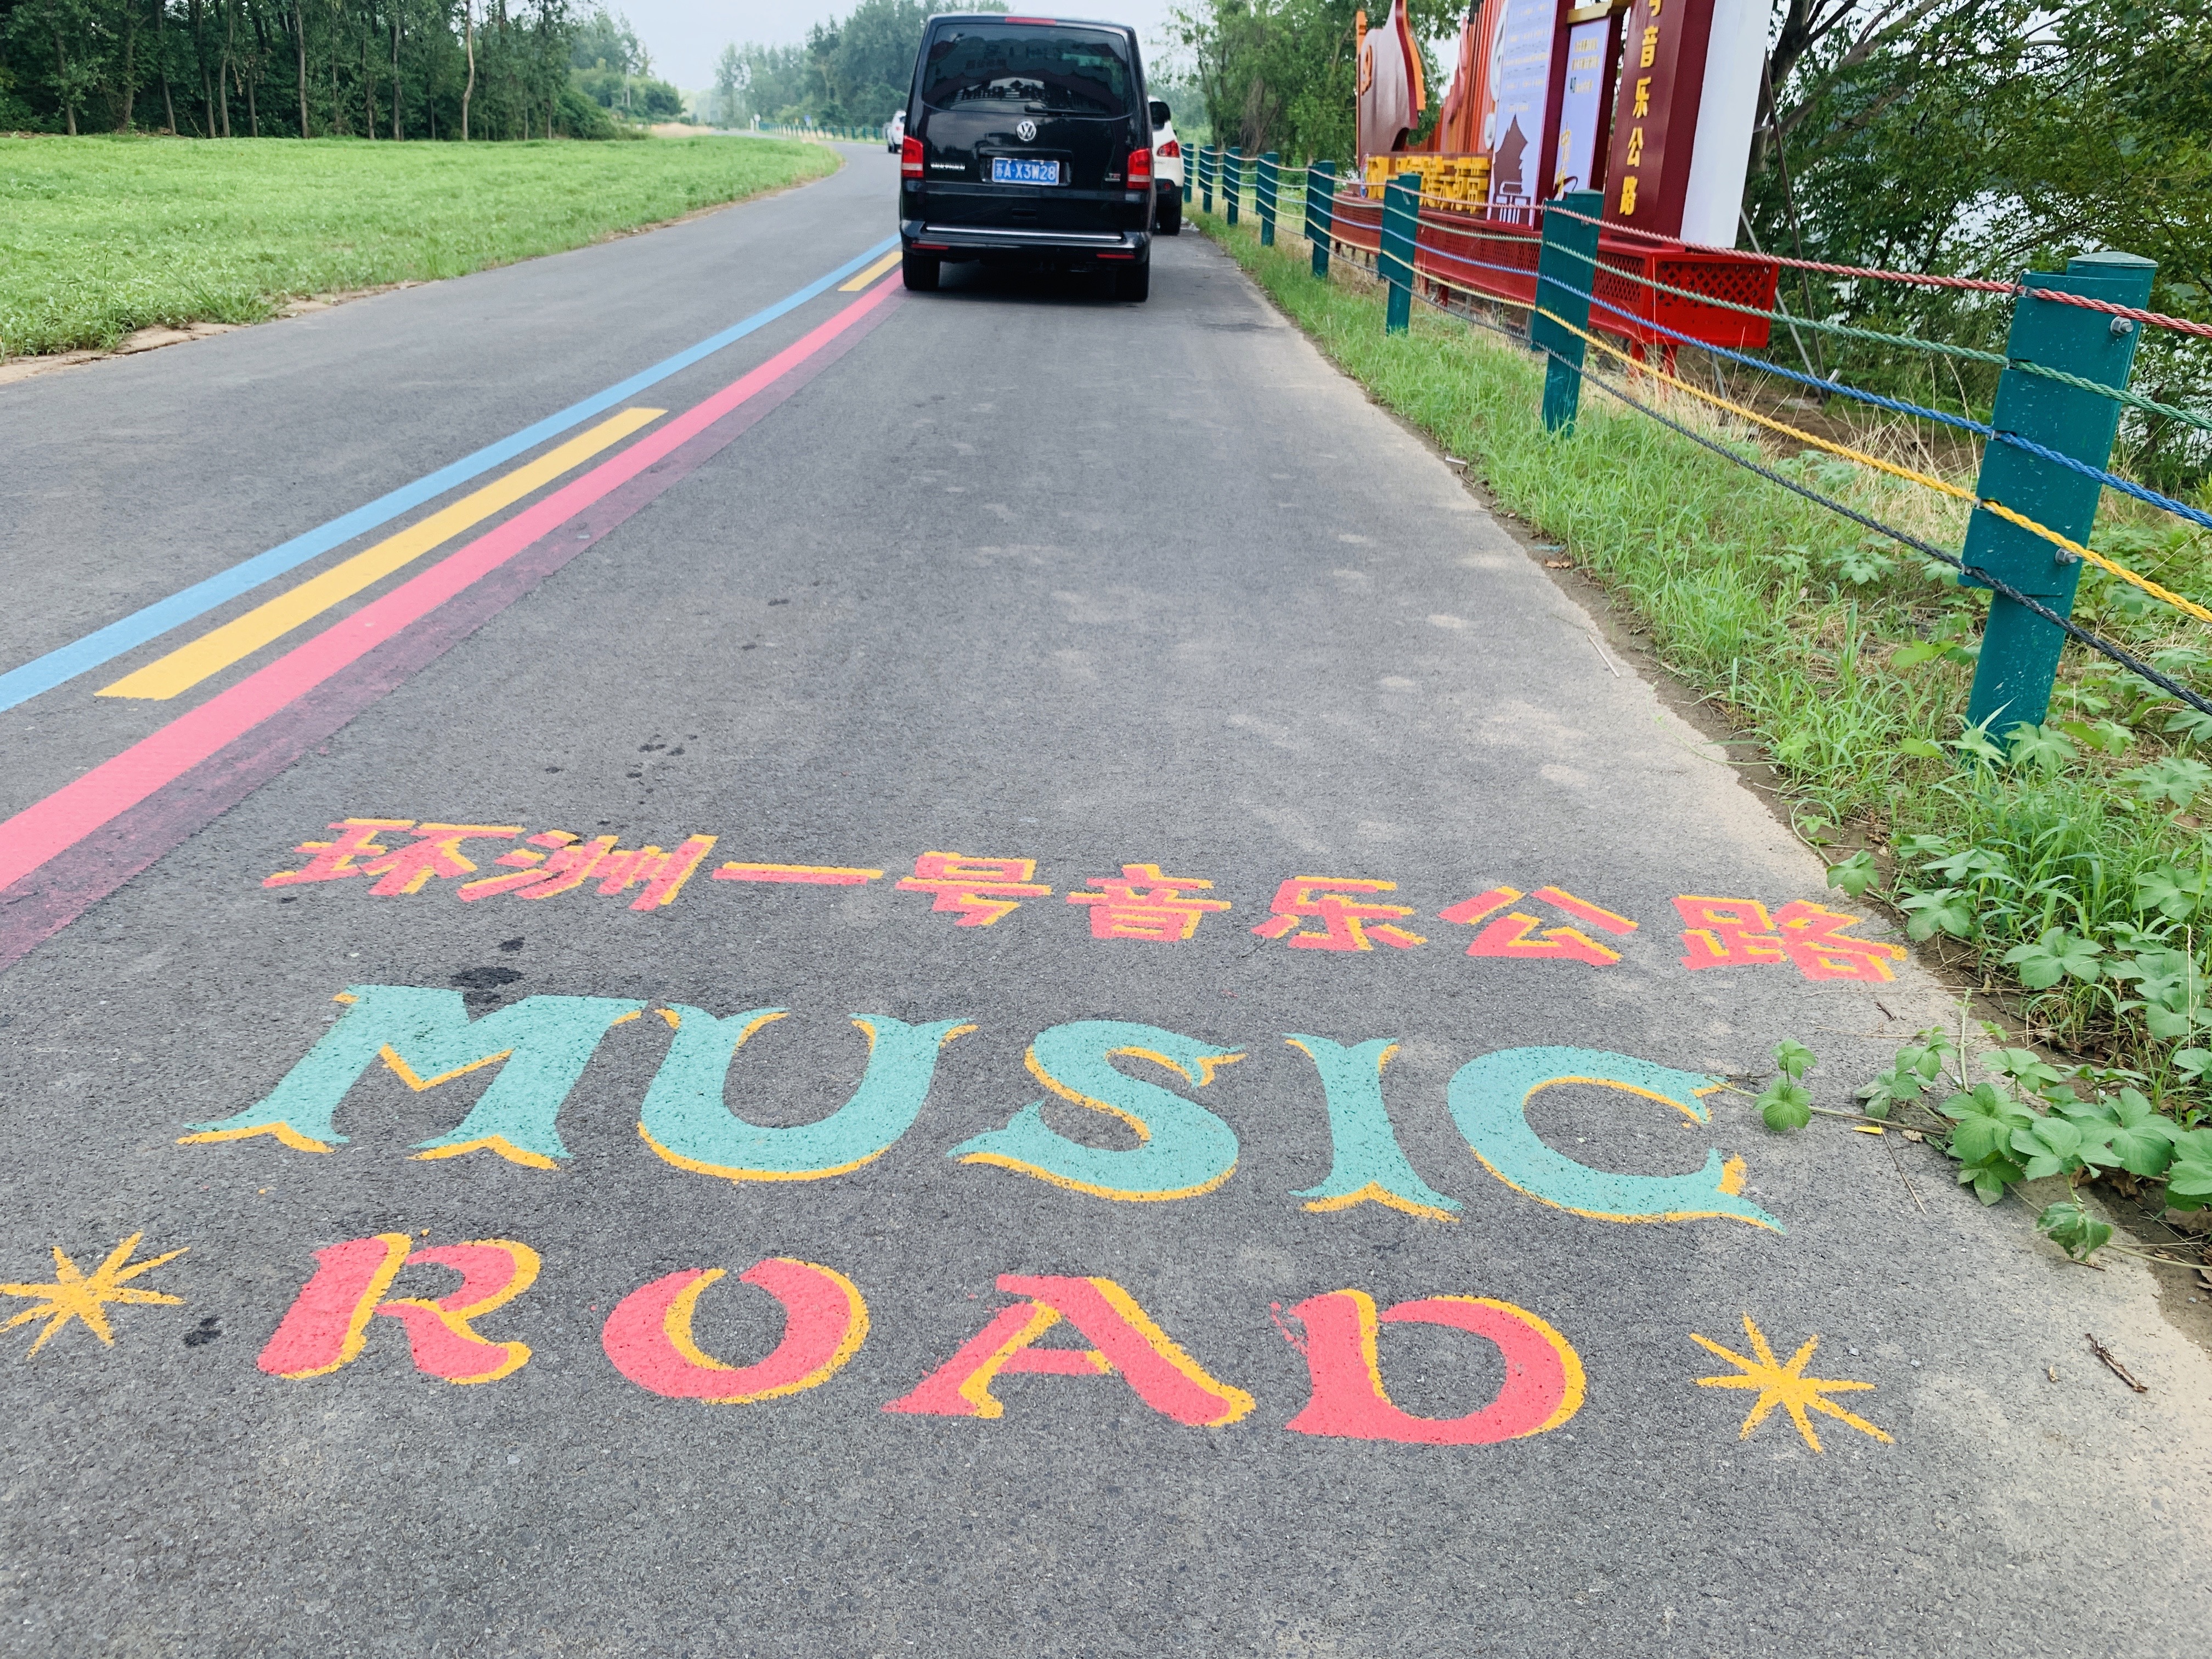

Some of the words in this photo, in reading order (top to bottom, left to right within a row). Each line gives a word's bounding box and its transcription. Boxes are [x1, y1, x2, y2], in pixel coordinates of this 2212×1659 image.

[261, 817, 1908, 983] 环洲一号音乐公路
[176, 983, 1787, 1235] MUSIC
[256, 1232, 1587, 1446] ROAD
